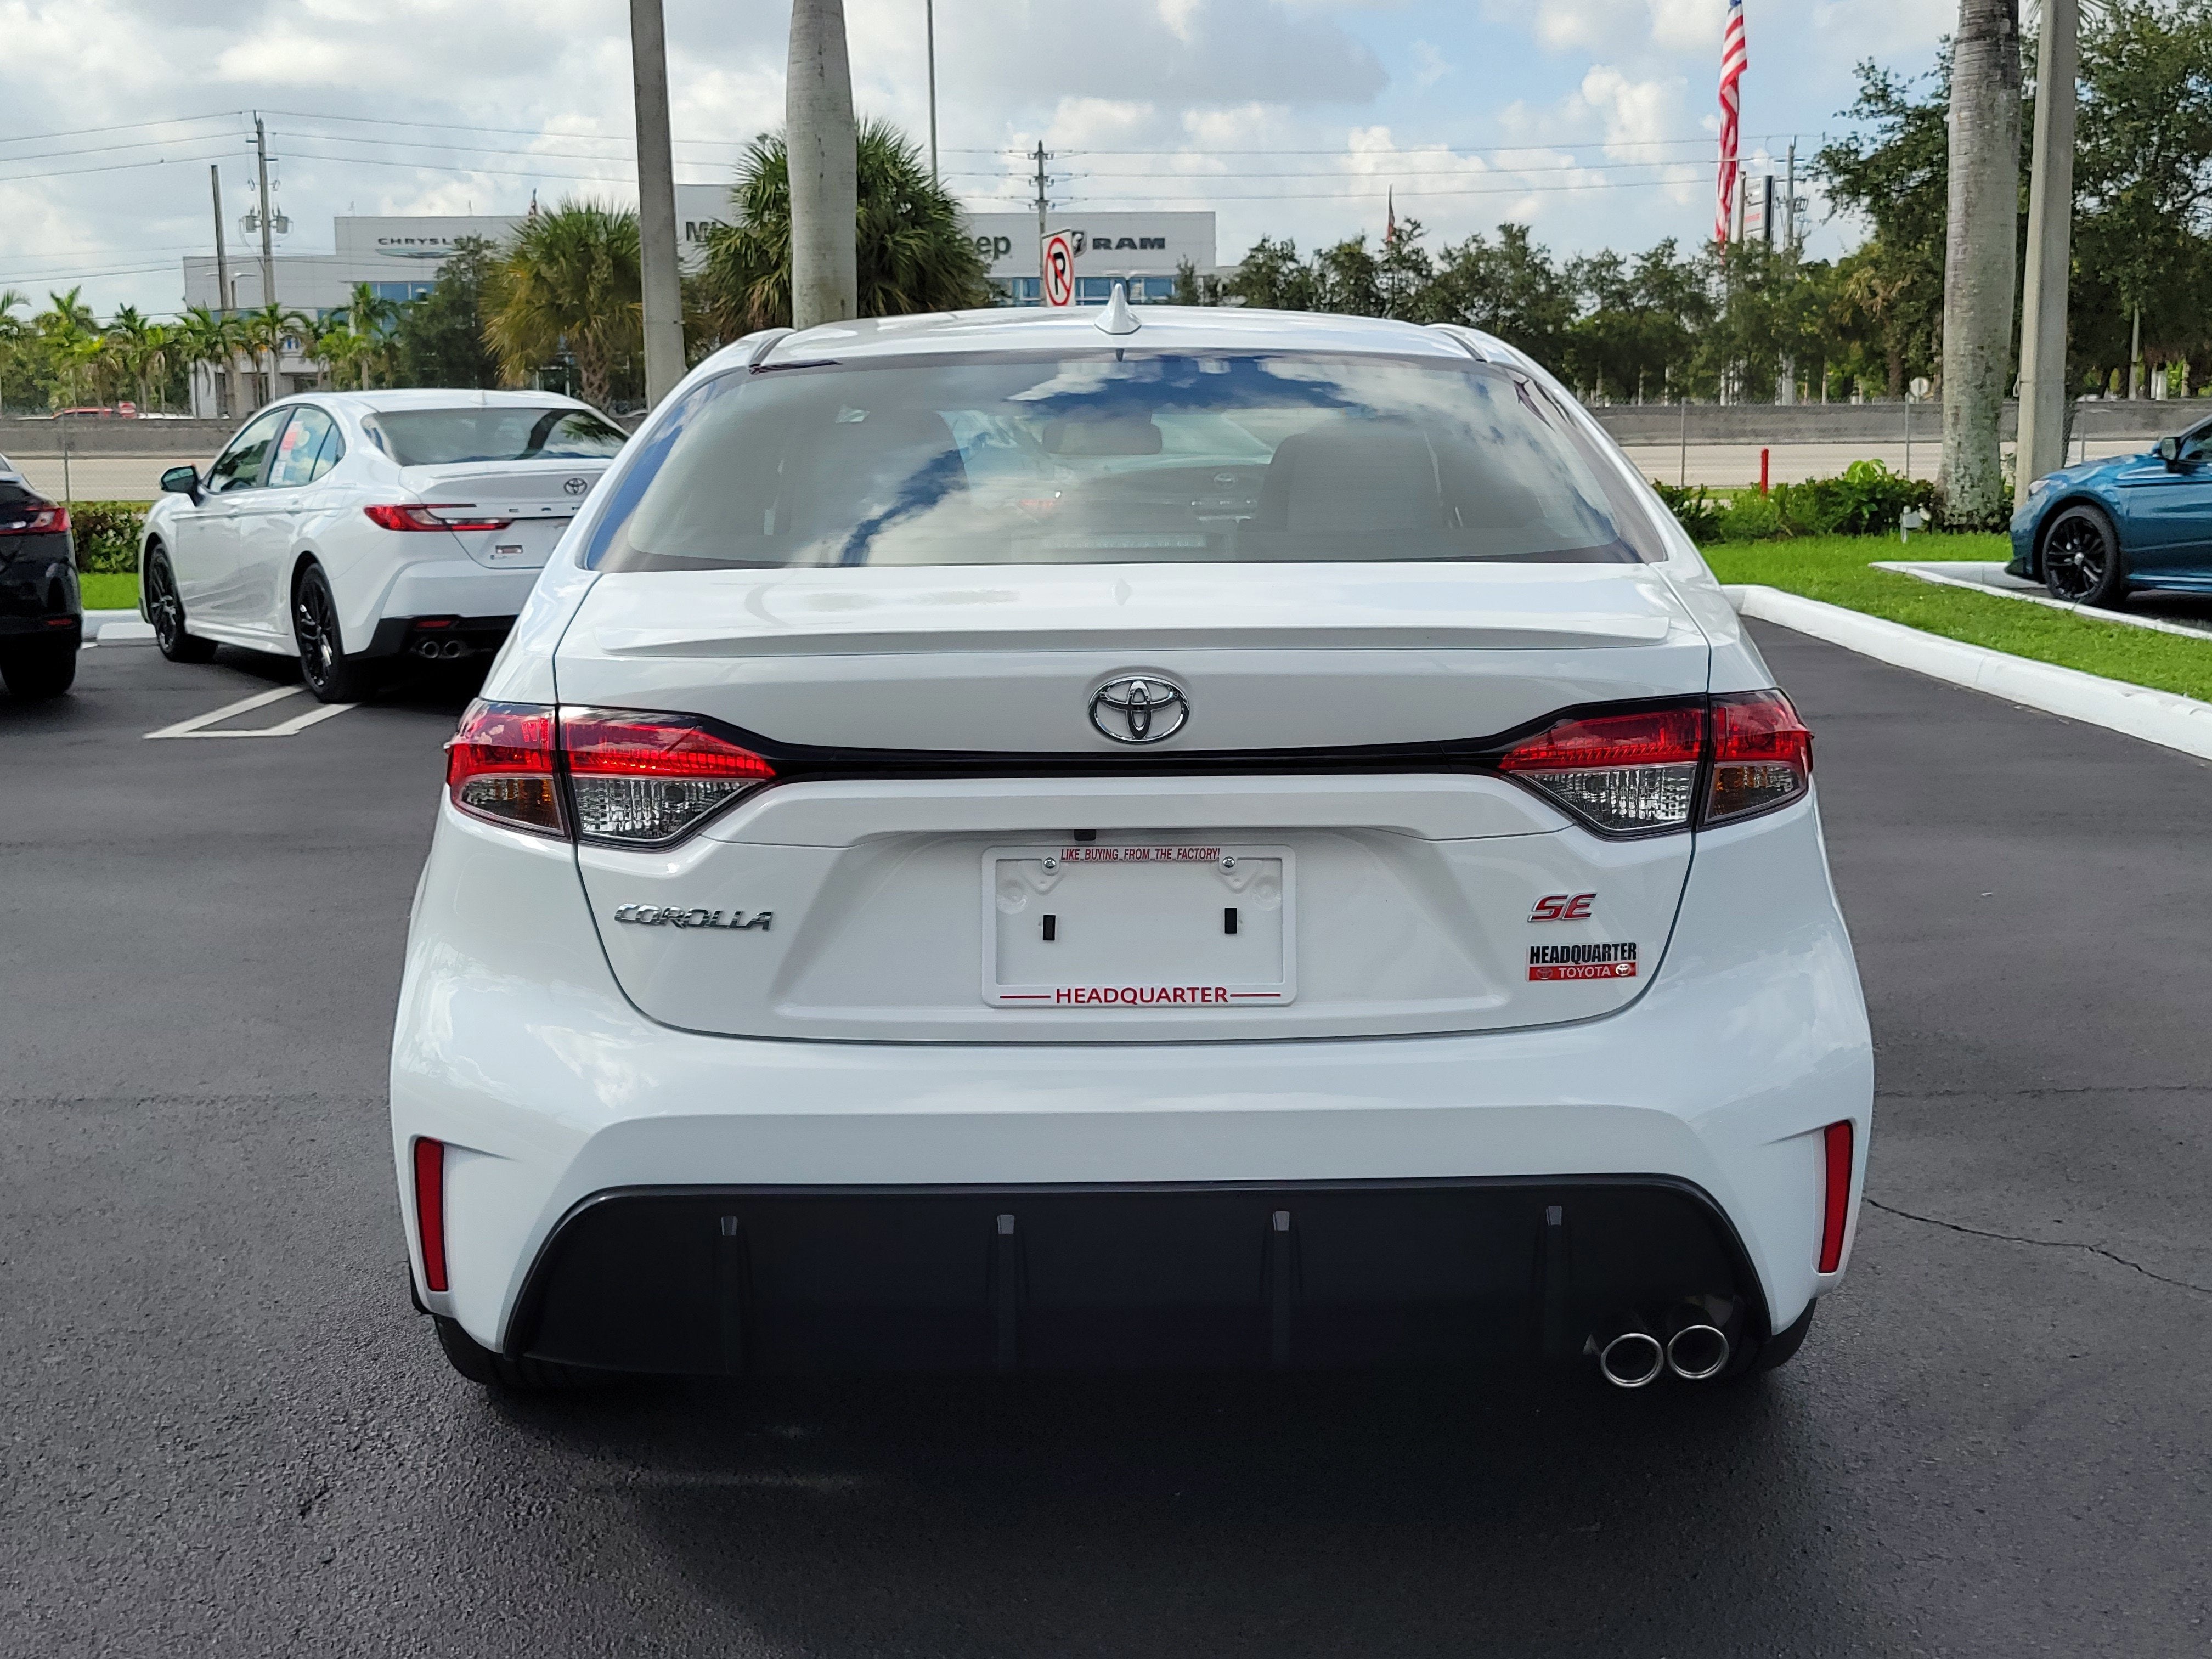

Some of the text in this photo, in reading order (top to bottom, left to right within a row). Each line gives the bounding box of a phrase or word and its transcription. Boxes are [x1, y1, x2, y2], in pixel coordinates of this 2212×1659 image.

[1092, 237, 1165, 250] RAM
[1053, 251, 1066, 295] P
[1060, 848, 1221, 860] LIKE BUYING FROM THE FACTORY!
[614, 903, 774, 931] COROLLA
[1527, 892, 1598, 923] SE
[1530, 941, 1637, 964] HEADQUARTER
[1559, 966, 1611, 978] TOYOTA
[1056, 987, 1228, 1005] HEADQUARTER
